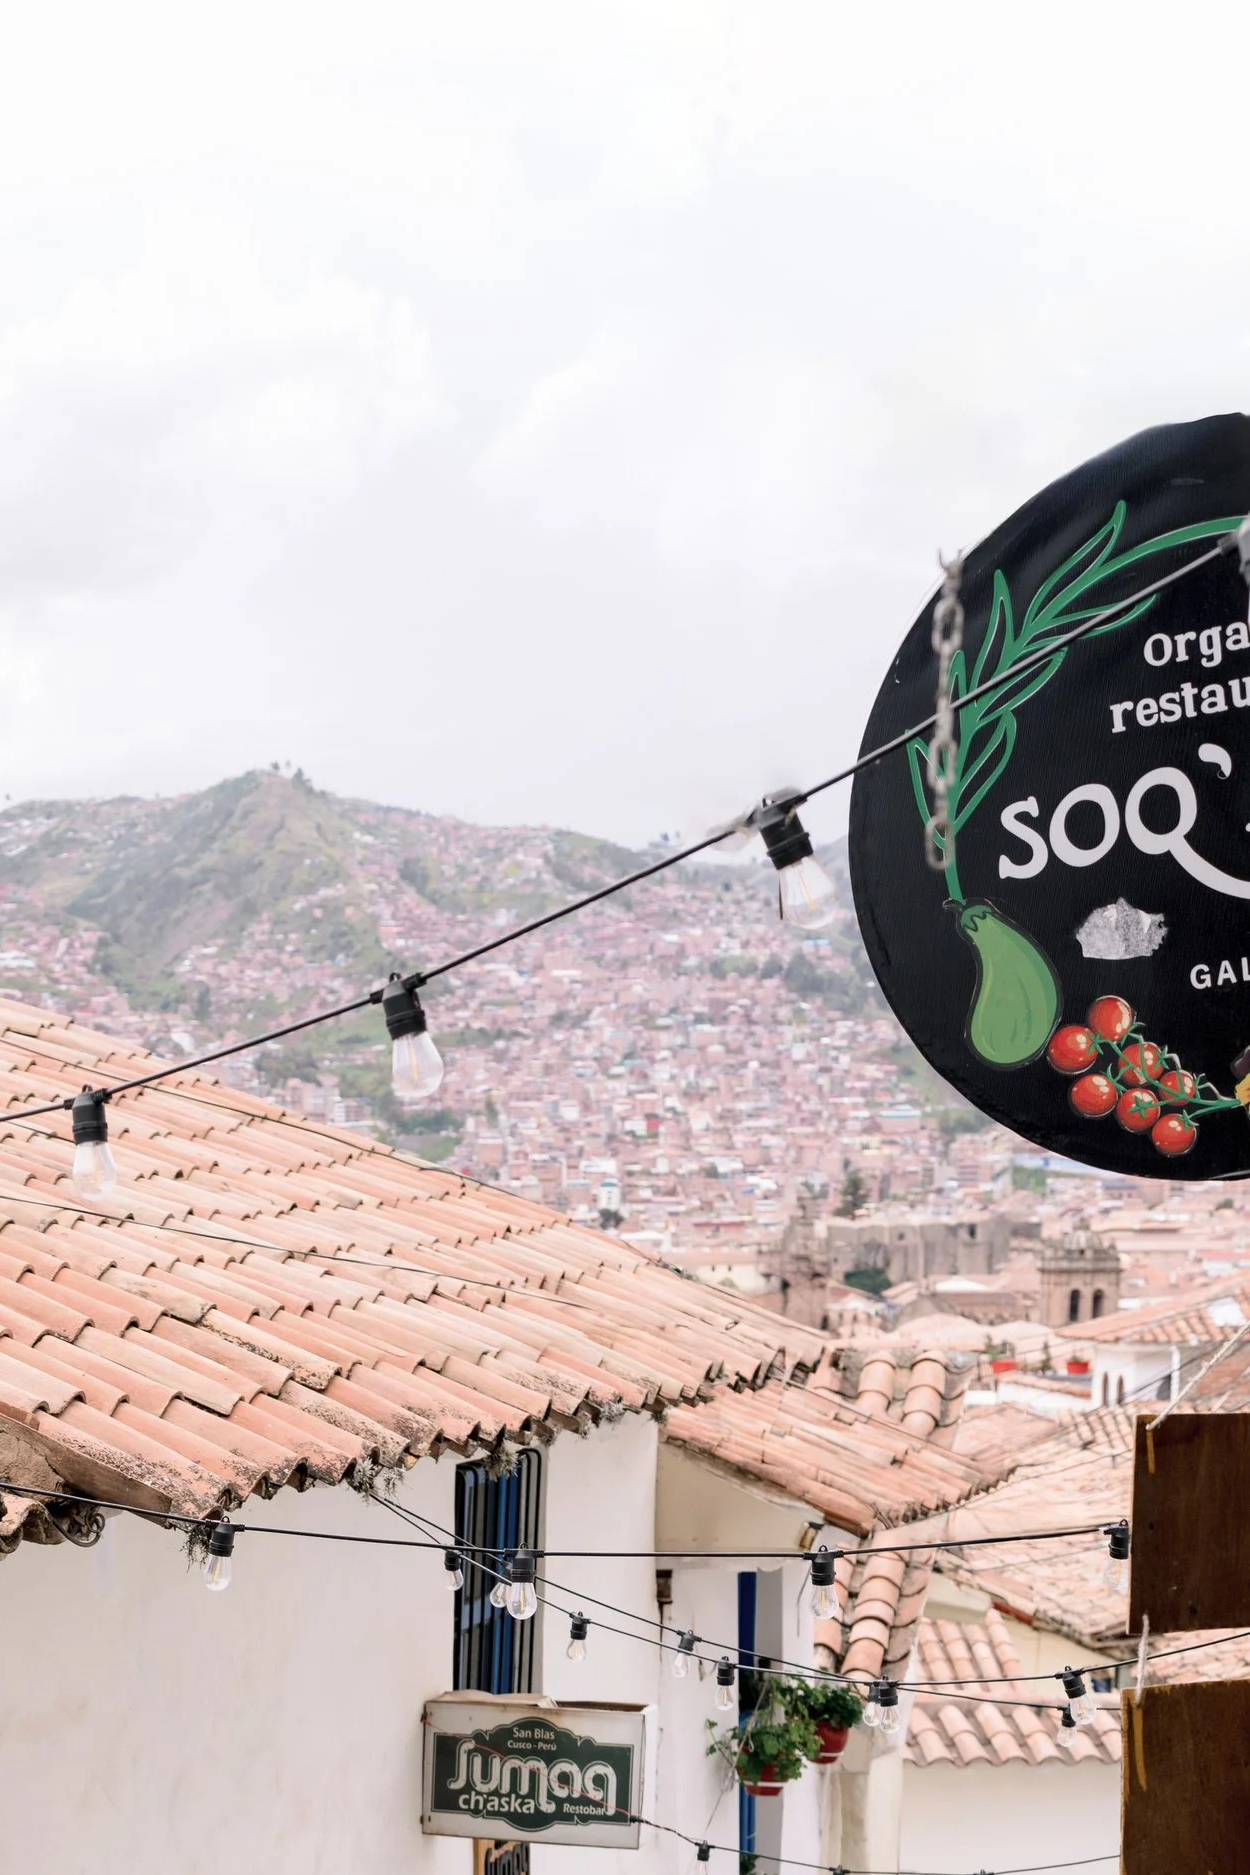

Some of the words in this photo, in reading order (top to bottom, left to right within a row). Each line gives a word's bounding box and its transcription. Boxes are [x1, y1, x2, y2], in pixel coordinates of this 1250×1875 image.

[1144, 621, 1250, 668] Orga
[1110, 676, 1250, 733] restau
[998, 742, 1250, 901] SOQ'
[507, 1740, 532, 1749] Cusco
[513, 1727, 532, 1738] San
[534, 1728, 555, 1740] Blas
[563, 1803, 607, 1816] Restobar
